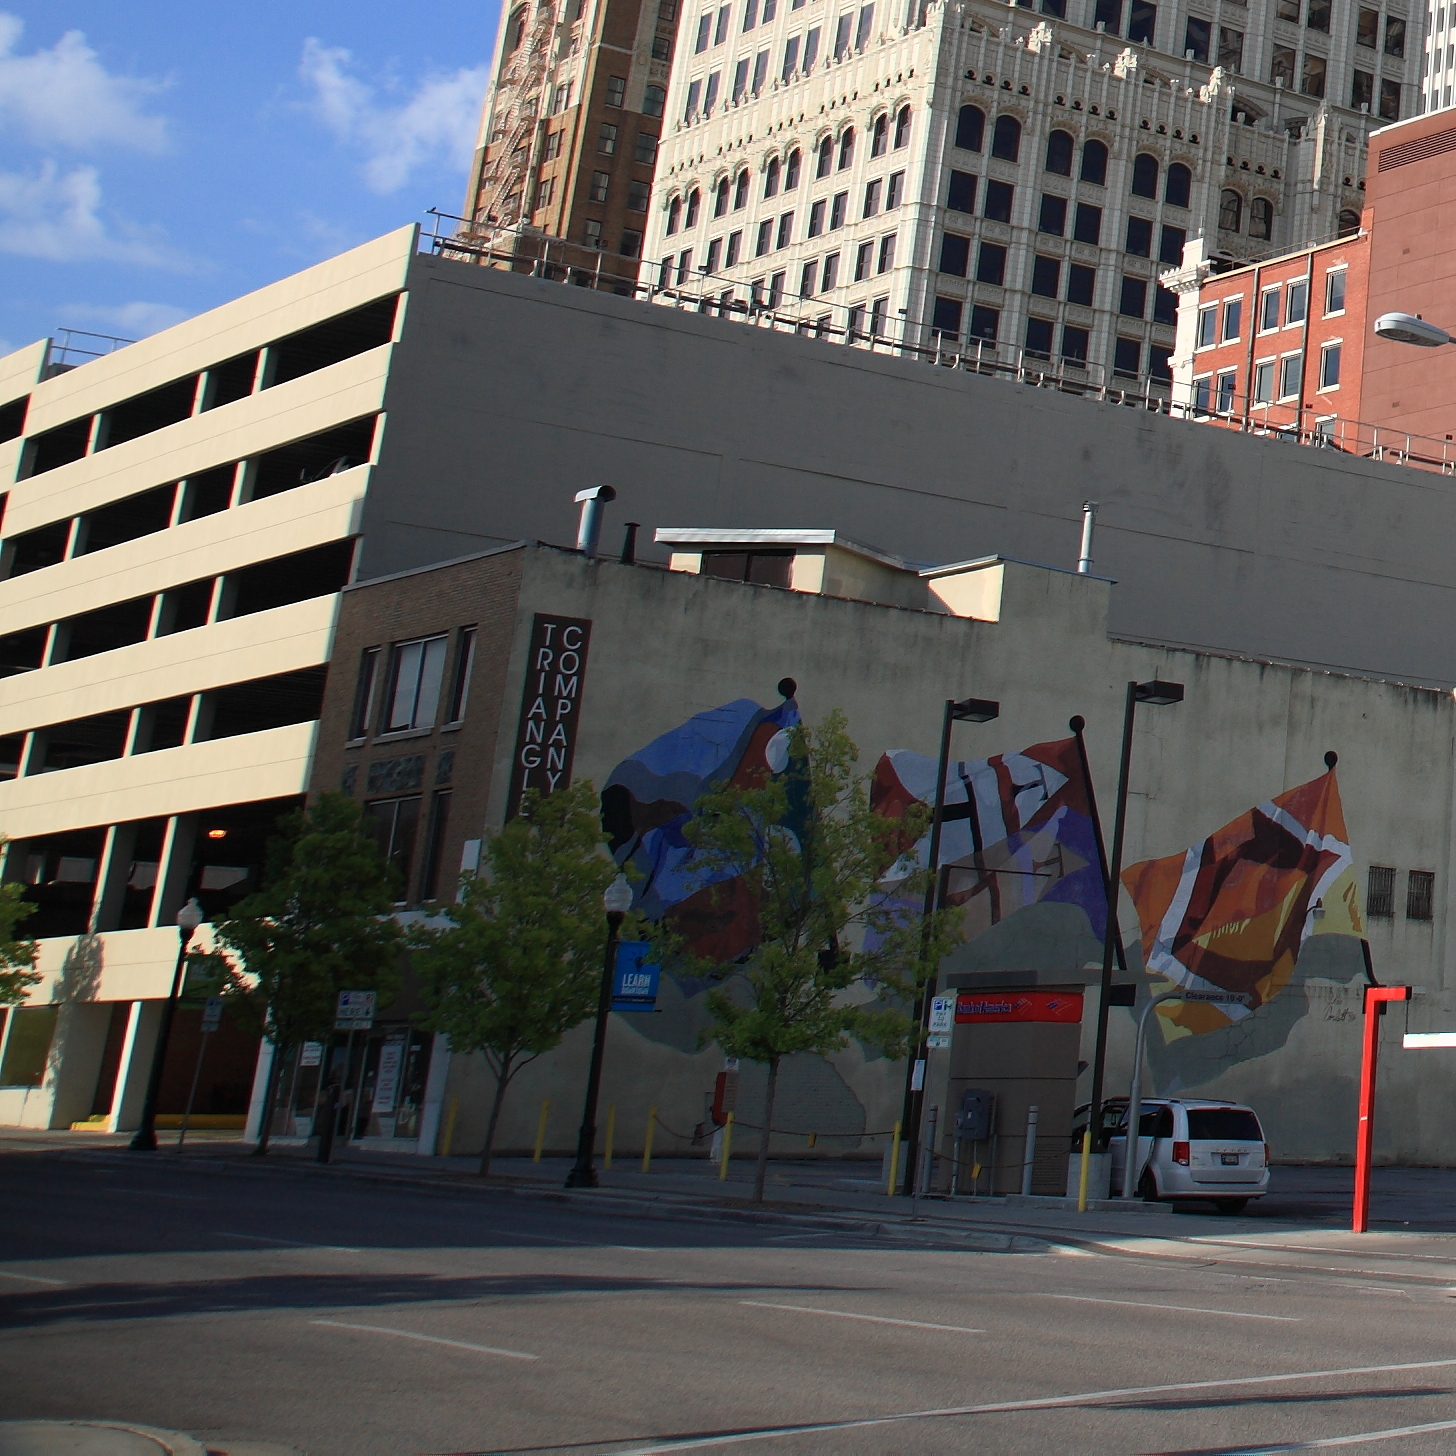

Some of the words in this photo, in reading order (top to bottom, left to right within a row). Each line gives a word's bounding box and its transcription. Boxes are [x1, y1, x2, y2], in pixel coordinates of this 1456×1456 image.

[546, 626, 583, 793] COMPANY
[518, 623, 557, 816] TRIANGLE
[622, 973, 652, 987] LEARN
[1185, 992, 1224, 1001] Clearance
[982, 1000, 1012, 1014] America
